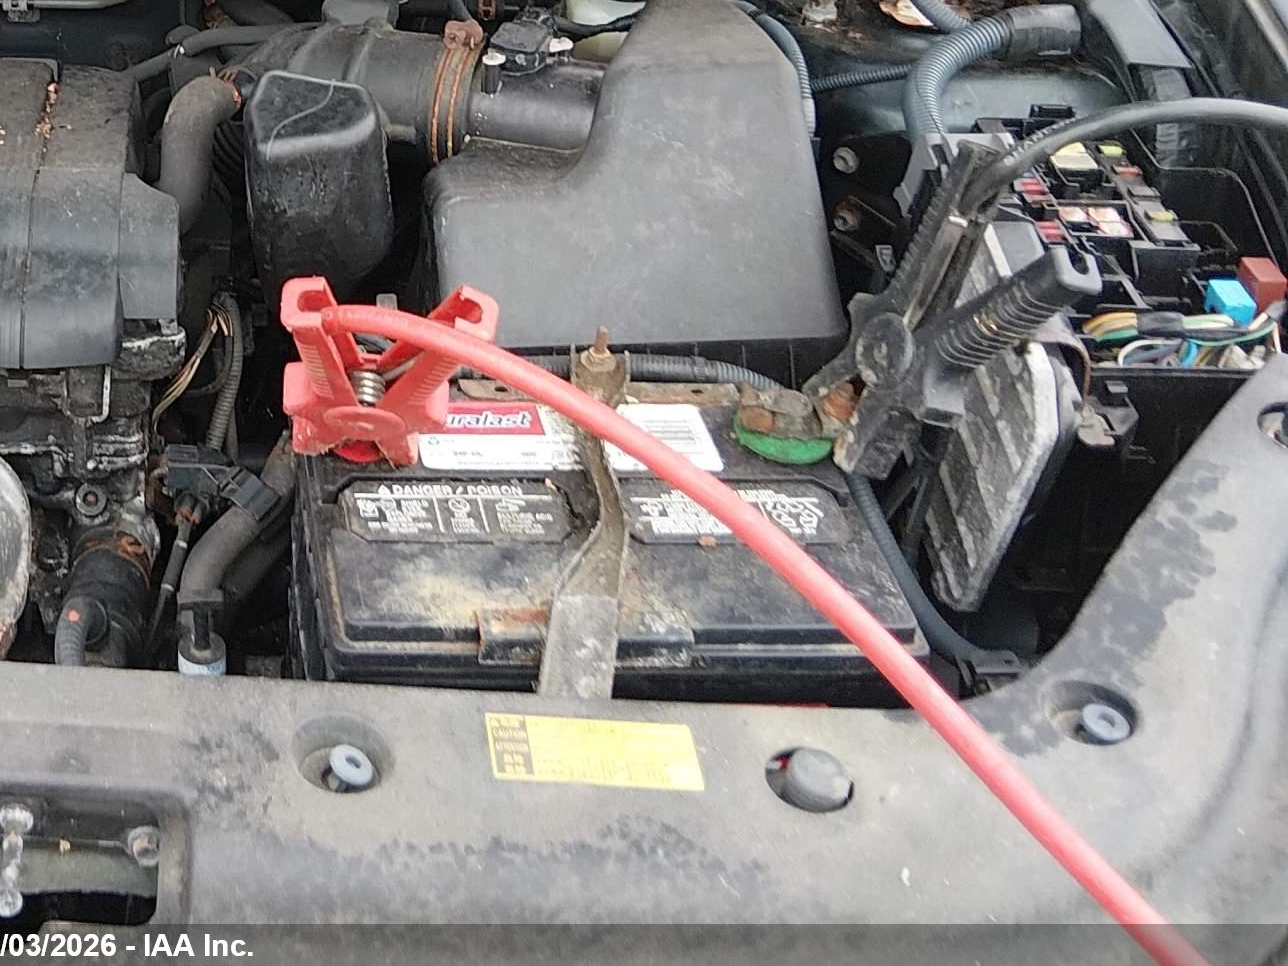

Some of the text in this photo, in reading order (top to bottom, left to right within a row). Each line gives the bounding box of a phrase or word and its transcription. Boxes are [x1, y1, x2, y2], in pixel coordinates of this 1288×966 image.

[392, 484, 453, 496] DANGER
[467, 485, 524, 496] POISON
[492, 728, 528, 739] CAUTION
